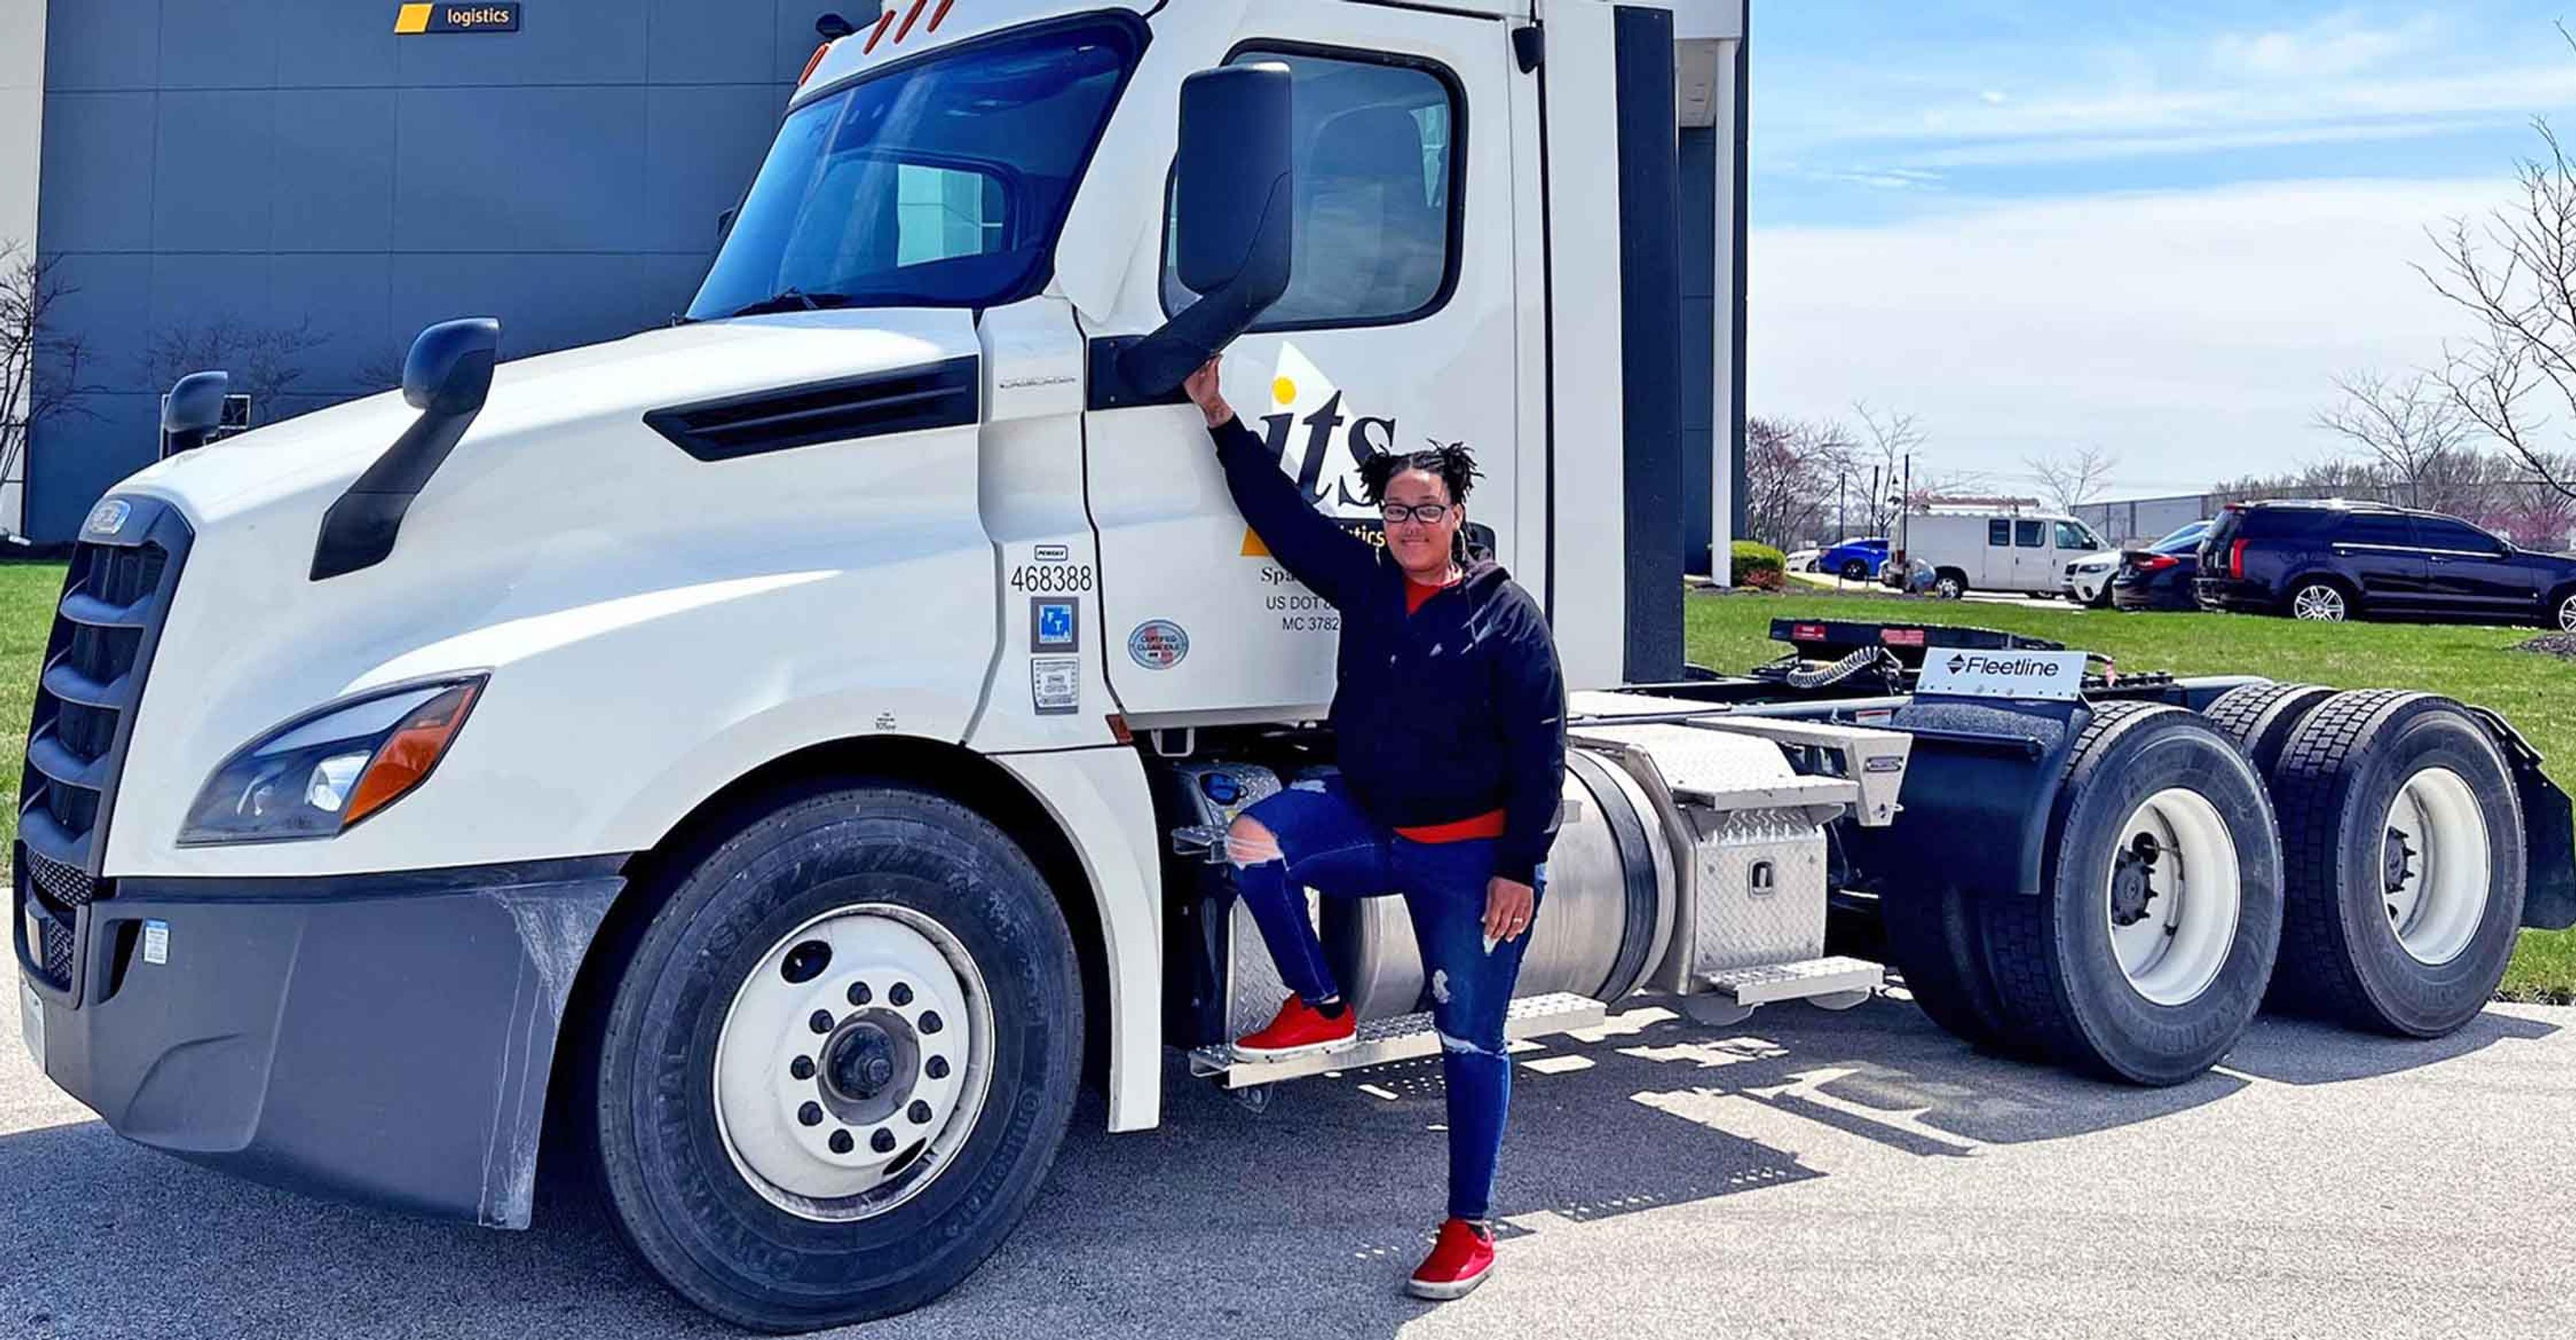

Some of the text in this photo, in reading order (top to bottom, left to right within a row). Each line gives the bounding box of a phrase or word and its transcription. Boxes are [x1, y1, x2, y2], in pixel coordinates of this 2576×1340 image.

[447, 7, 509, 27] logistics
[1011, 565, 1092, 591] 468388
[1266, 596, 1286, 610] US
[1290, 596, 1320, 610] DOT
[1282, 617, 1340, 631] MC 3782
[1966, 656, 2059, 677] Fleetline
